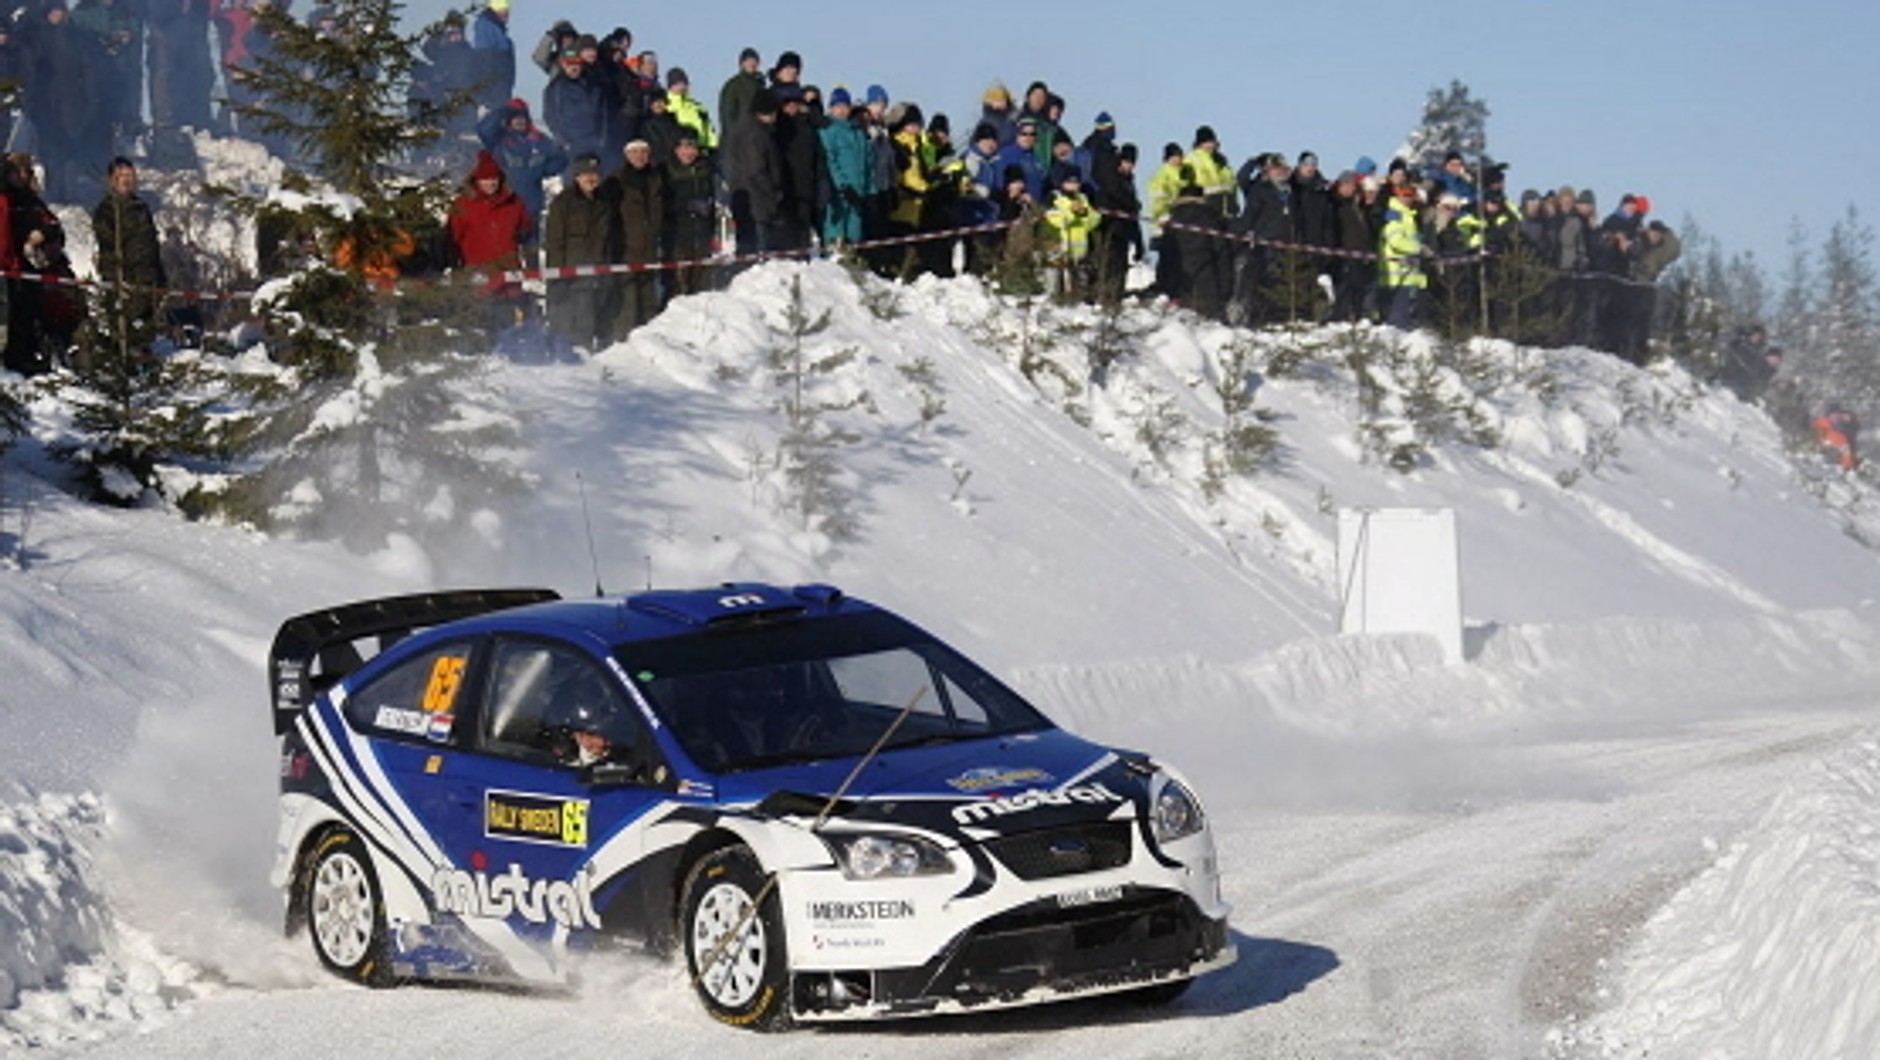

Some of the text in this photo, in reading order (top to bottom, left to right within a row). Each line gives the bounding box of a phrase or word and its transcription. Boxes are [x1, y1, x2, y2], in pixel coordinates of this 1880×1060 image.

[490, 799, 519, 828] RALLY
[521, 806, 560, 834] SWEDEN
[951, 782, 1122, 824] mistral
[432, 850, 602, 930] mistral
